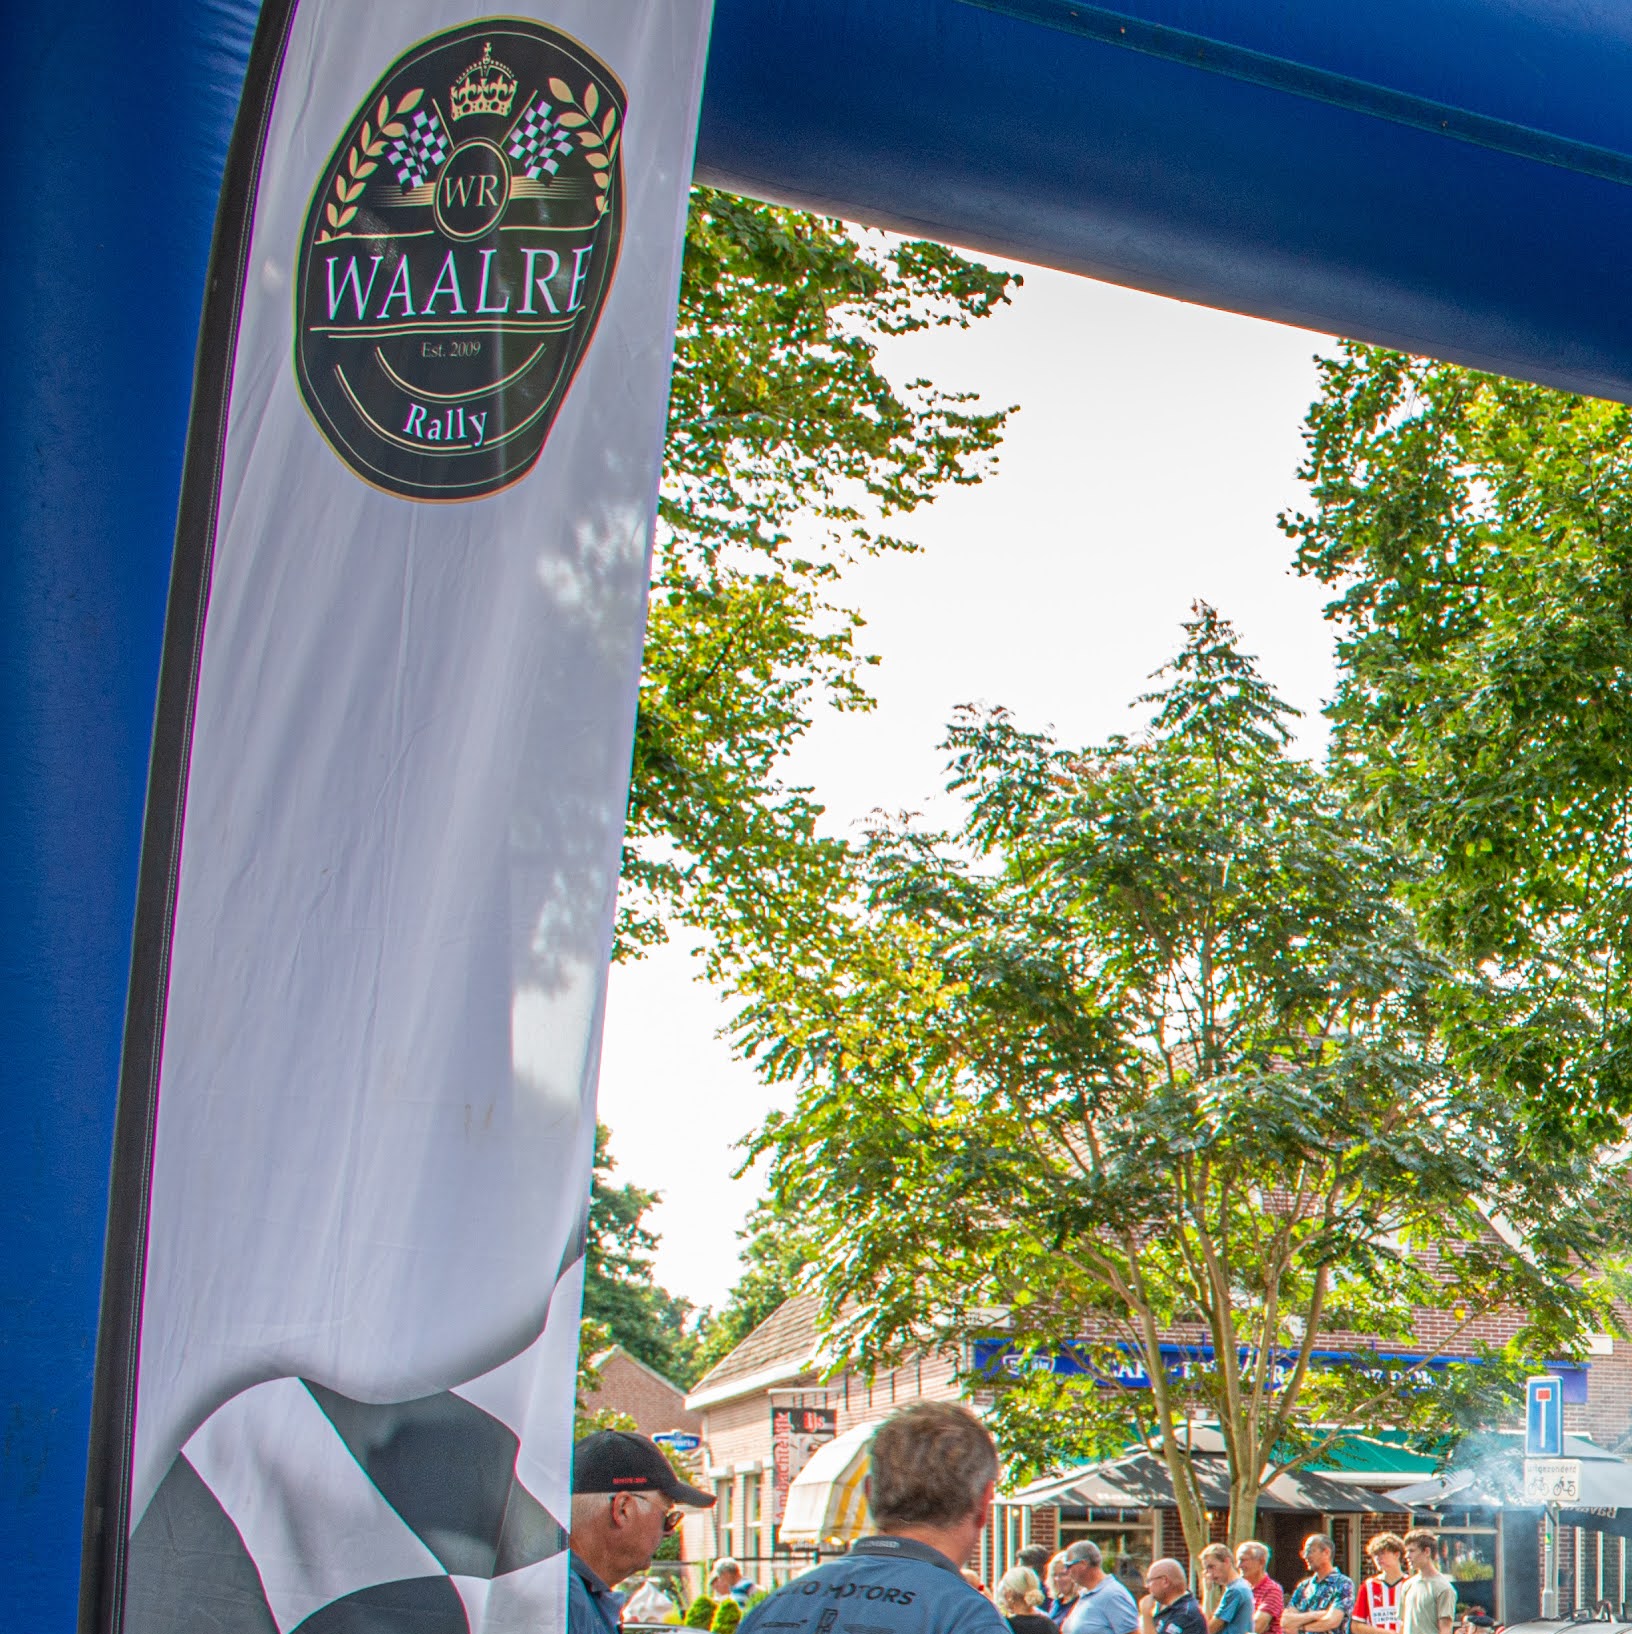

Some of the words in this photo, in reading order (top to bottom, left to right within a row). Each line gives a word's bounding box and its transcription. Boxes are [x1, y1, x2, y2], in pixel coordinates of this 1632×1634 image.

[445, 174, 498, 208] WR
[325, 245, 593, 320] WAALRE
[421, 342, 447, 358] Est.
[450, 341, 481, 358] 2009
[402, 402, 488, 447] Rally
